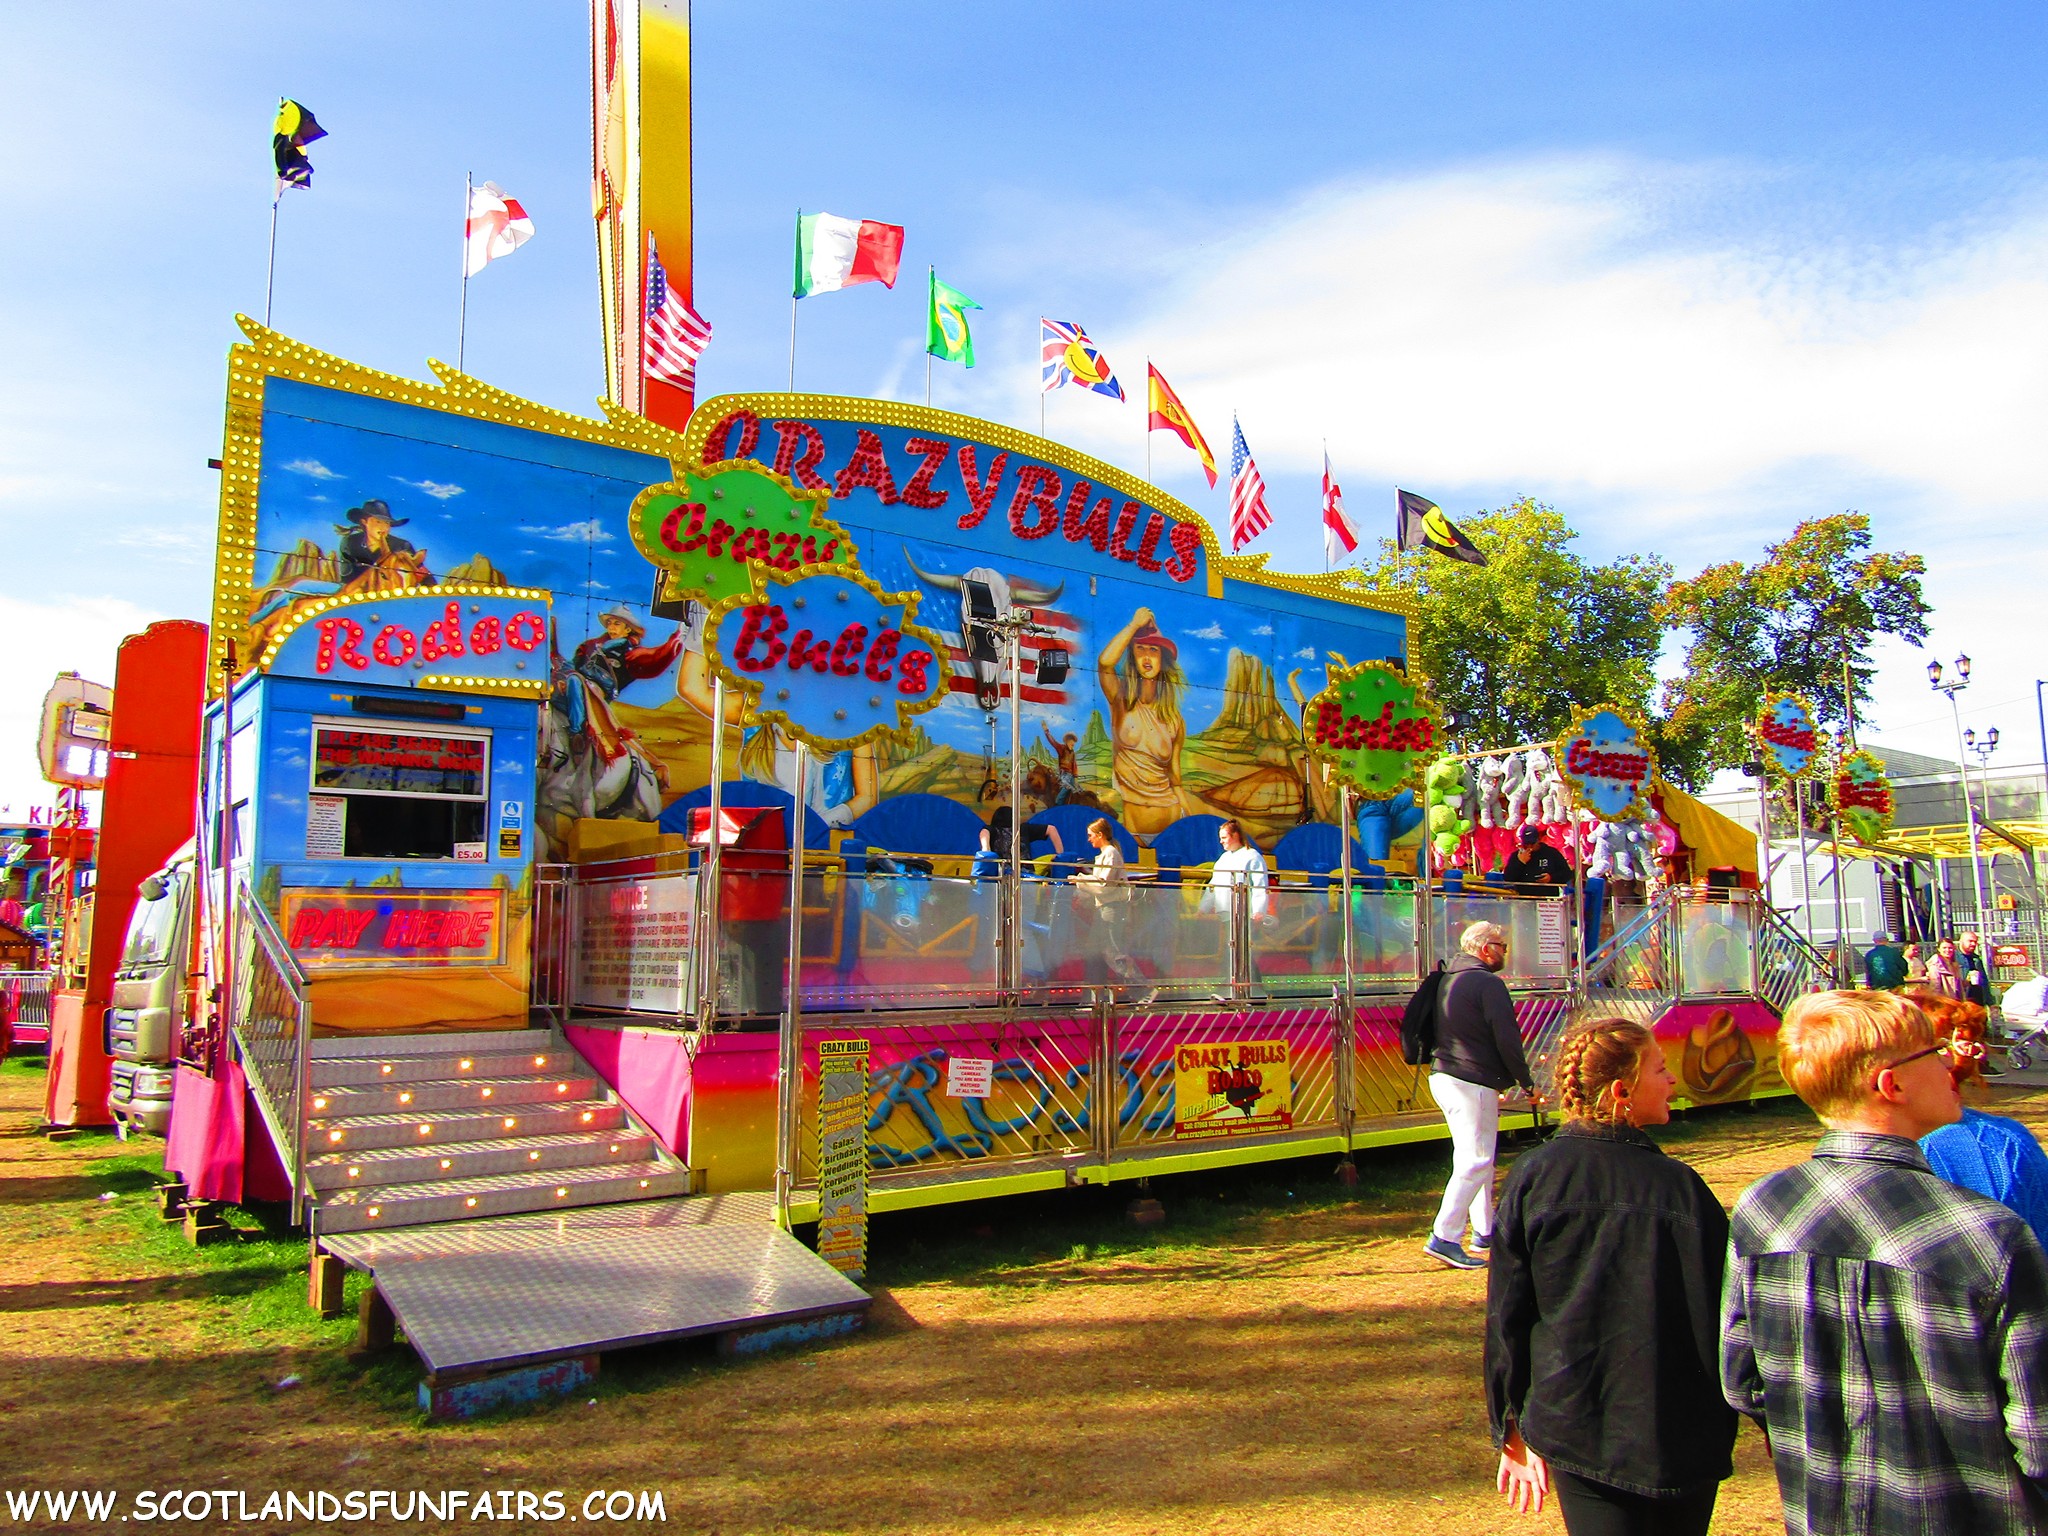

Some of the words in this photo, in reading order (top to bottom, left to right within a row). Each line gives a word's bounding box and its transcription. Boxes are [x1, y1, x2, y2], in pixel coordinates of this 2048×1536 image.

[661, 503, 839, 572] Crazy
[314, 601, 546, 674] Rodeo
[733, 604, 933, 694] Bulls
[1316, 701, 1436, 751] Rodeo
[328, 731, 393, 749] PLEASE
[397, 736, 442, 752] READ
[446, 740, 477, 755] ALL
[319, 747, 353, 764] THE
[358, 750, 434, 768] WARNING
[438, 756, 484, 771] SIGNS
[610, 886, 648, 912] NOTICE
[290, 908, 377, 949] PAY
[383, 909, 494, 949] HERE
[821, 1042, 846, 1054] CRAZY
[846, 1041, 869, 1052] BULLS
[1177, 1048, 1231, 1072] CRAZY
[1238, 1045, 1286, 1068] BULLS
[1207, 1069, 1263, 1095] RODEO
[823, 1100, 842, 1111] Hire
[1183, 1105, 1203, 1120] Hire
[825, 1146, 863, 1165] Birthdays
[832, 1137, 855, 1150] Galas
[824, 1158, 864, 1177] Weddings
[824, 1169, 863, 1189] Corporate
[832, 1183, 857, 1198] Events
